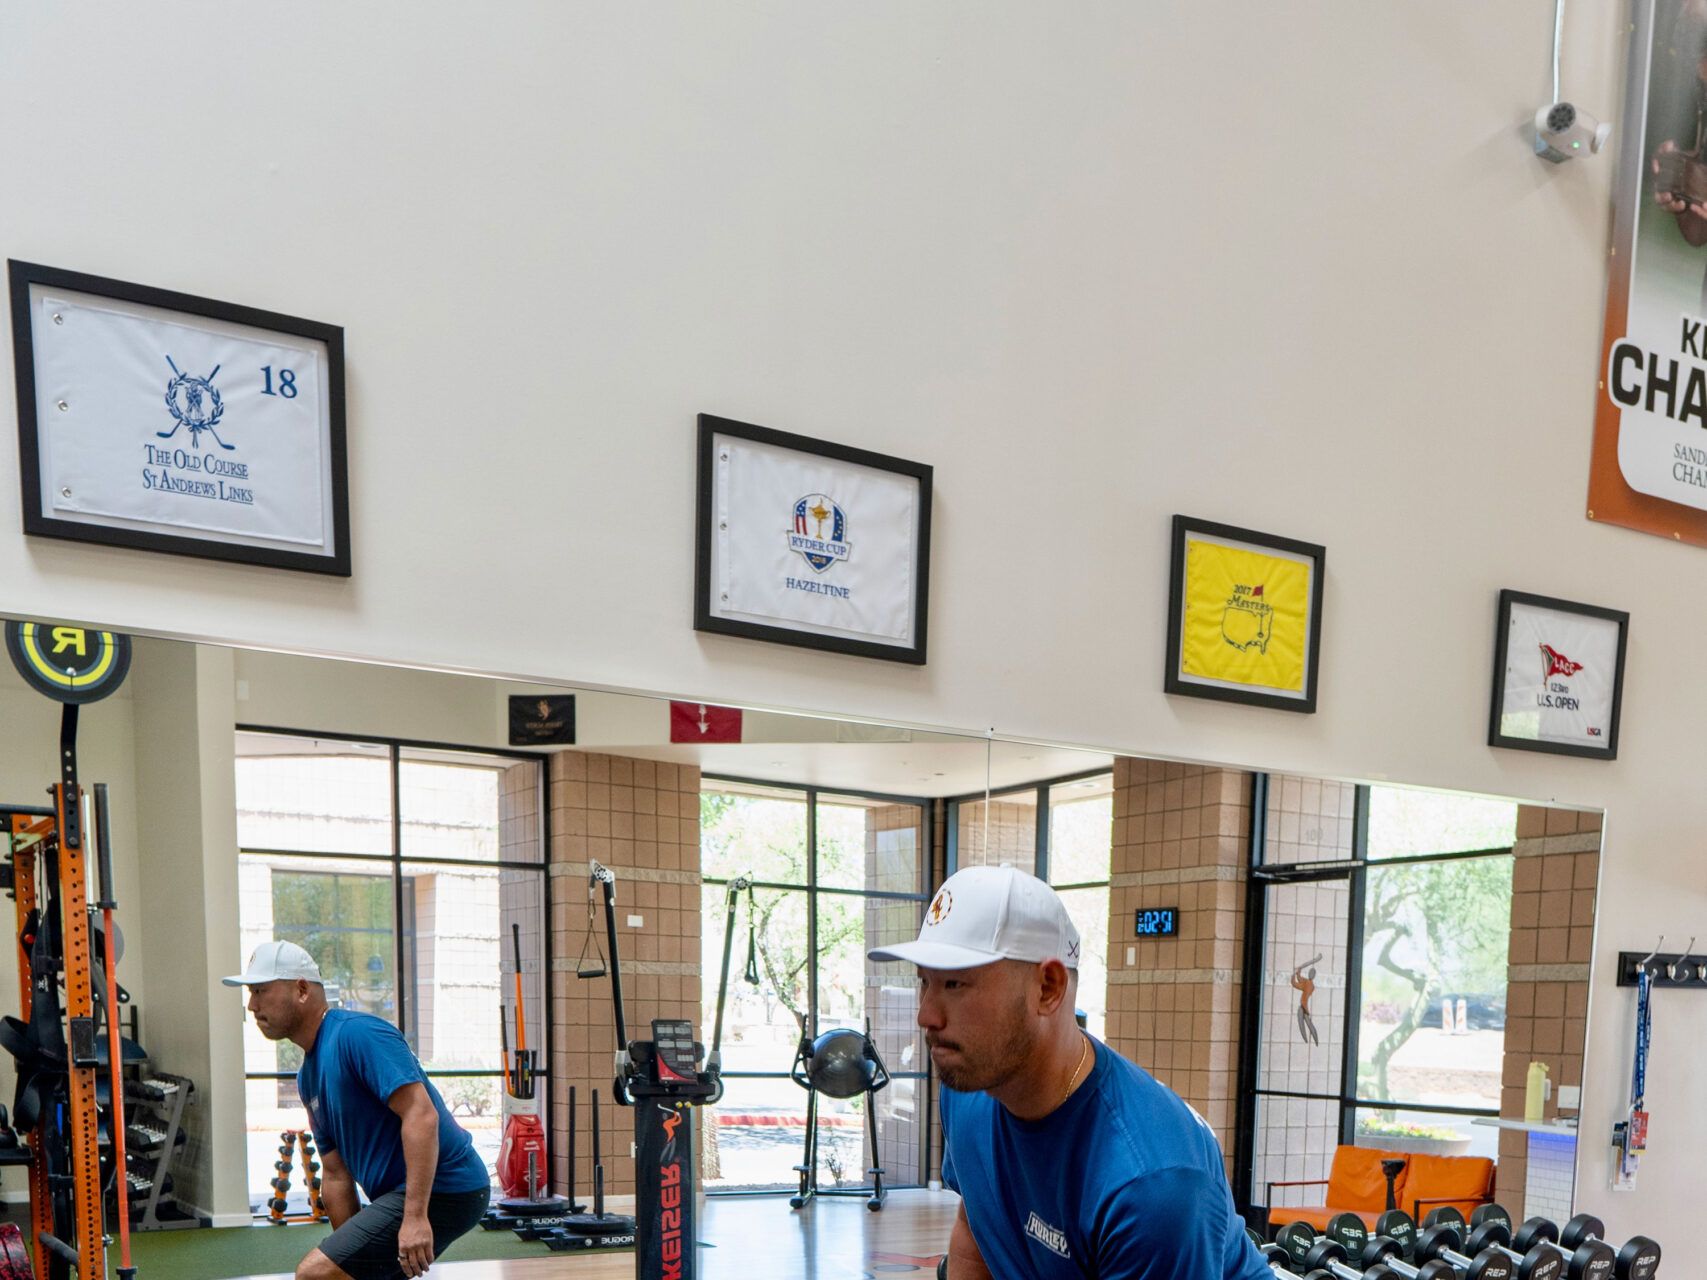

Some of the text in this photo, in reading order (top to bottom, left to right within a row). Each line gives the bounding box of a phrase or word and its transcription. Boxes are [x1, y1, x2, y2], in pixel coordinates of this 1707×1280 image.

[260, 365, 297, 399] 18
[791, 536, 847, 556] RYDER CUP
[786, 577, 850, 600] HAZELTINE
[1233, 584, 1252, 595] 2017
[1553, 655, 1575, 674] LACC
[1537, 693, 1580, 711] U.S. OPEN
[1030, 1216, 1068, 1253] HURLEY
[1535, 1260, 1558, 1278] REP
[1590, 1260, 1610, 1270] REP
[1636, 1255, 1656, 1266] REP
[1485, 1267, 1508, 1277] REP
